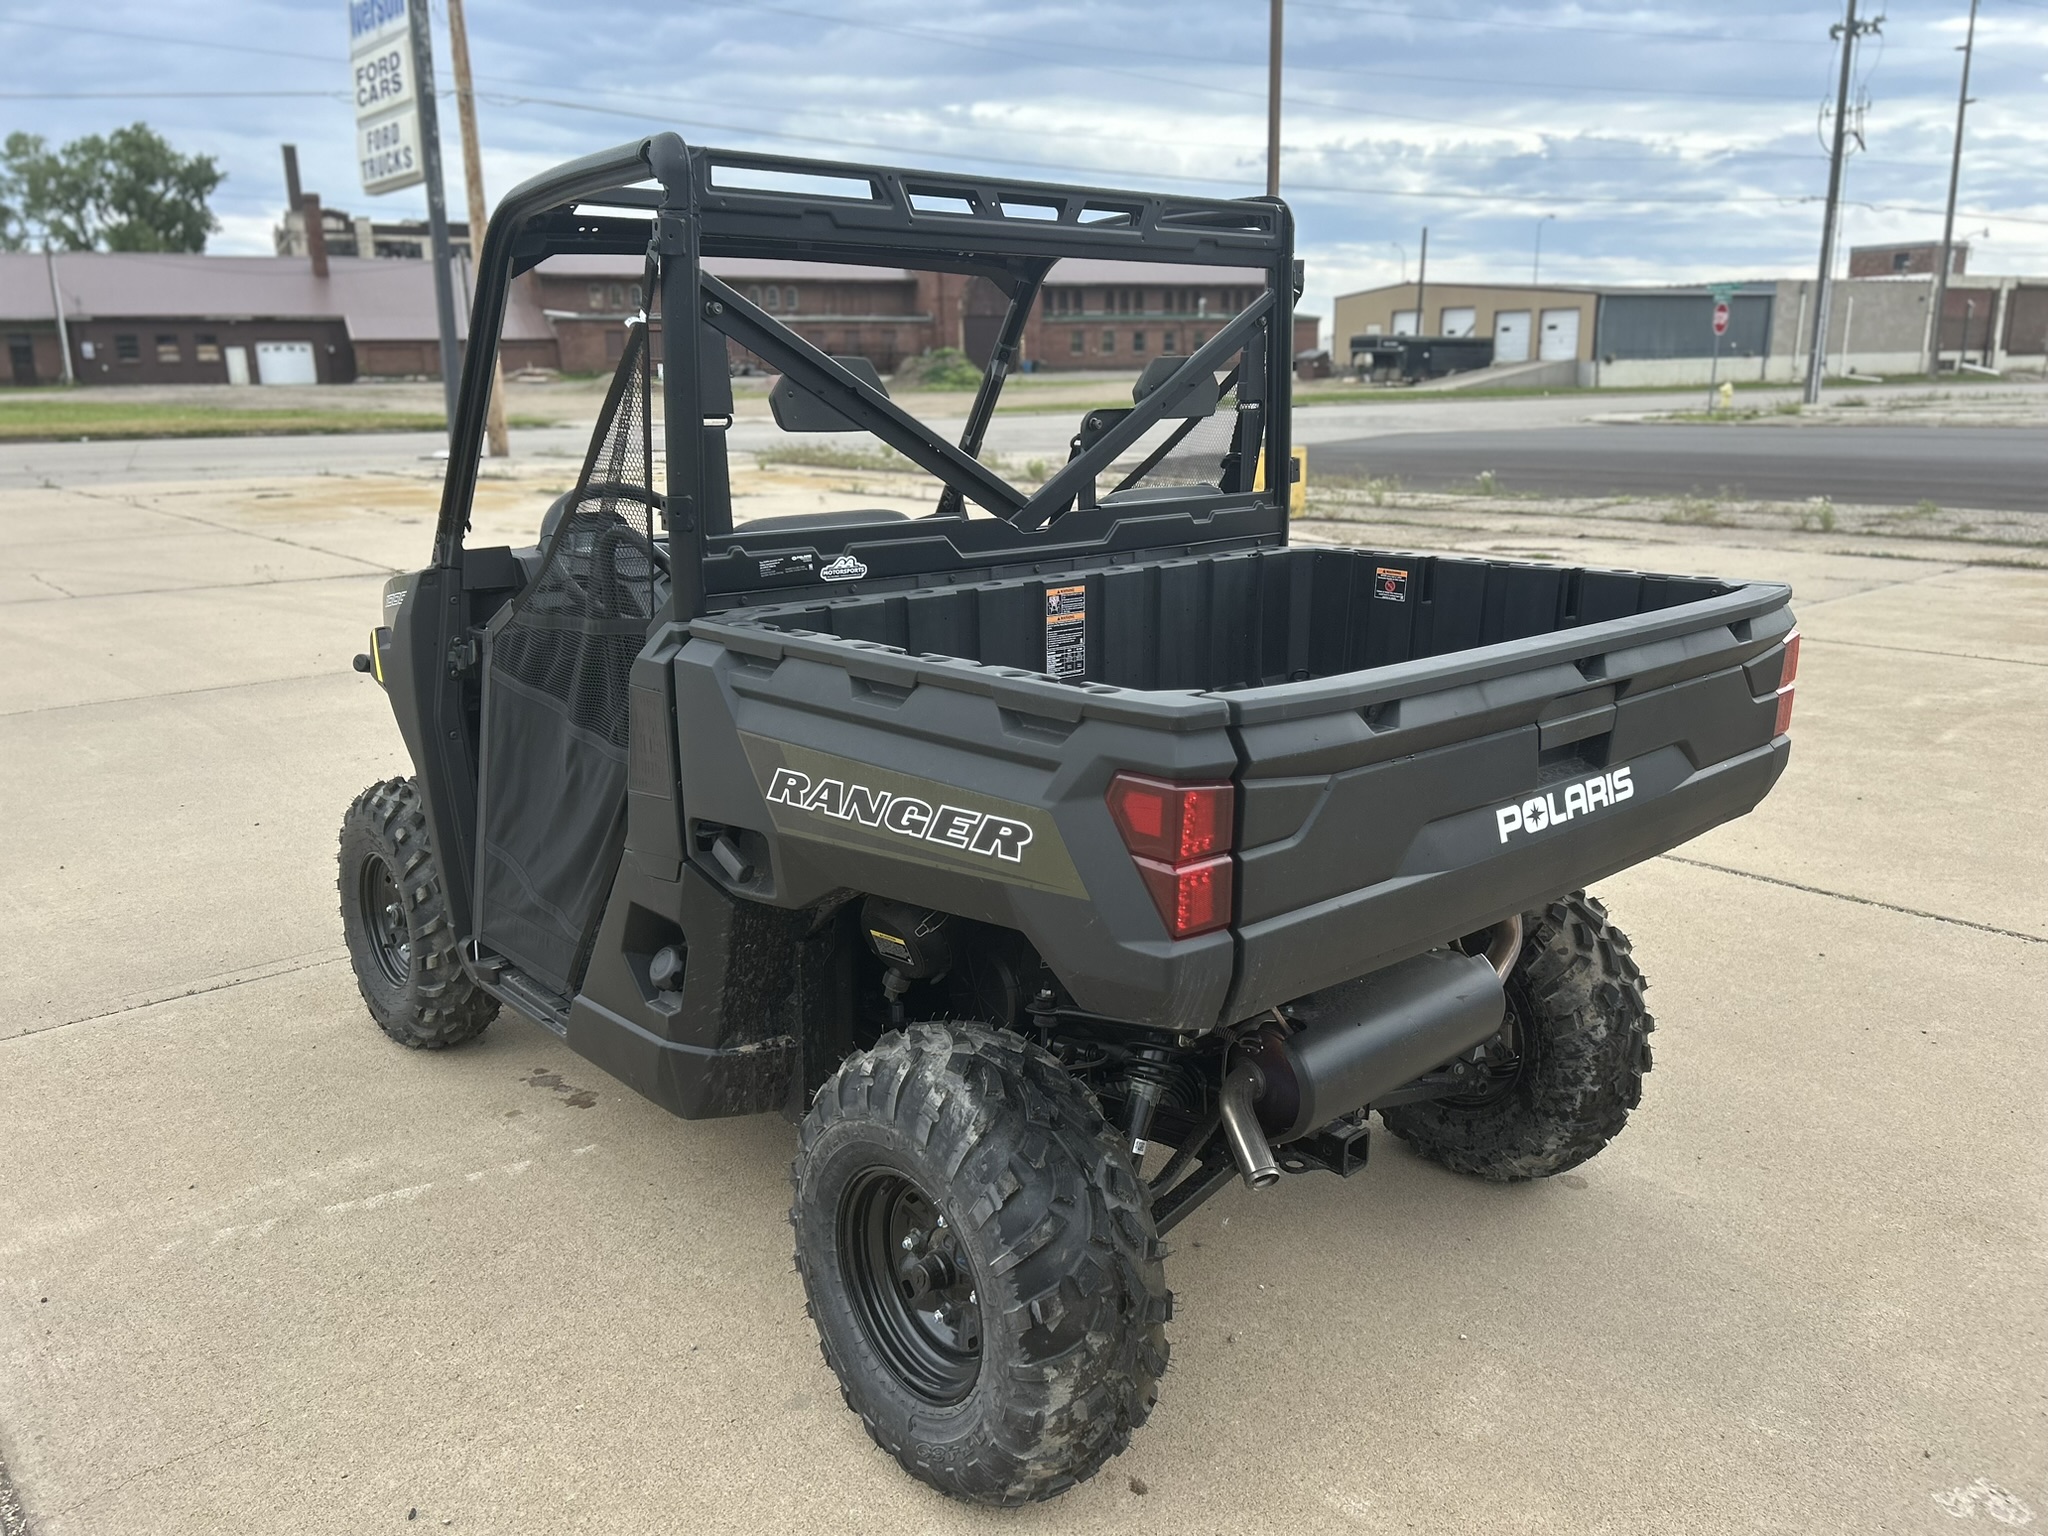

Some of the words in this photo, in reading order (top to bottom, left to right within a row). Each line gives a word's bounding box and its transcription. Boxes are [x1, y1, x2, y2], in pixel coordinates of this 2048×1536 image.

[356, 51, 401, 86] FORD
[357, 73, 403, 107] CARS
[367, 122, 400, 153] FORD
[361, 146, 413, 181] TRUCKS
[822, 567, 865, 576] MOTORSPORTS
[766, 768, 1033, 862] RANGER
[1496, 766, 1634, 844] POLARIS
